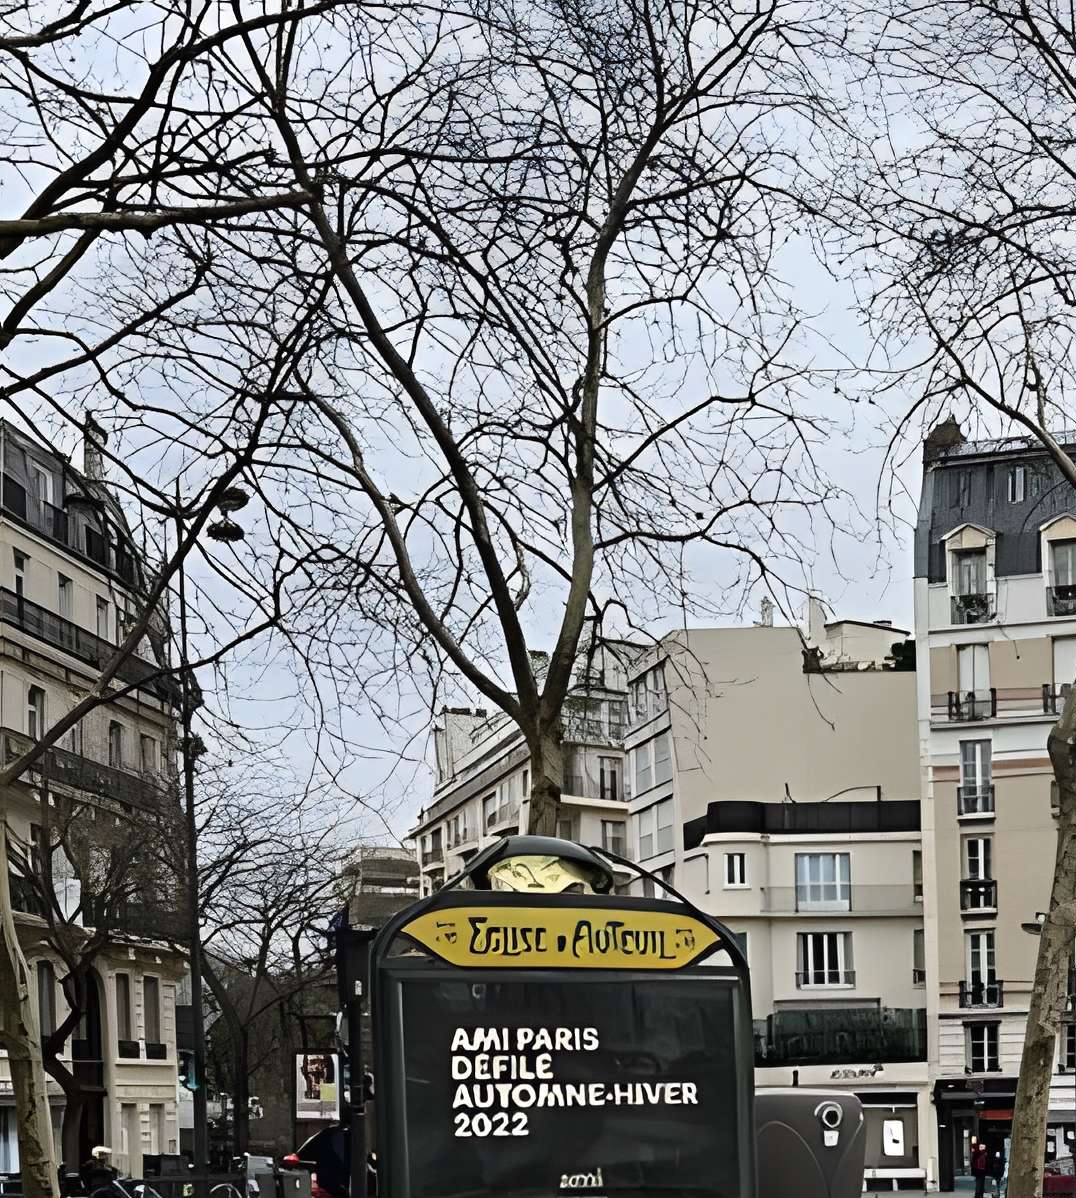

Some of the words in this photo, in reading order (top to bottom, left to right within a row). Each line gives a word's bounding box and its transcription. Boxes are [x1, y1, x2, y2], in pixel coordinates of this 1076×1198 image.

[450, 1027, 509, 1051] AMI
[516, 1027, 600, 1051] PARIS
[453, 1111, 530, 1137] 2022
